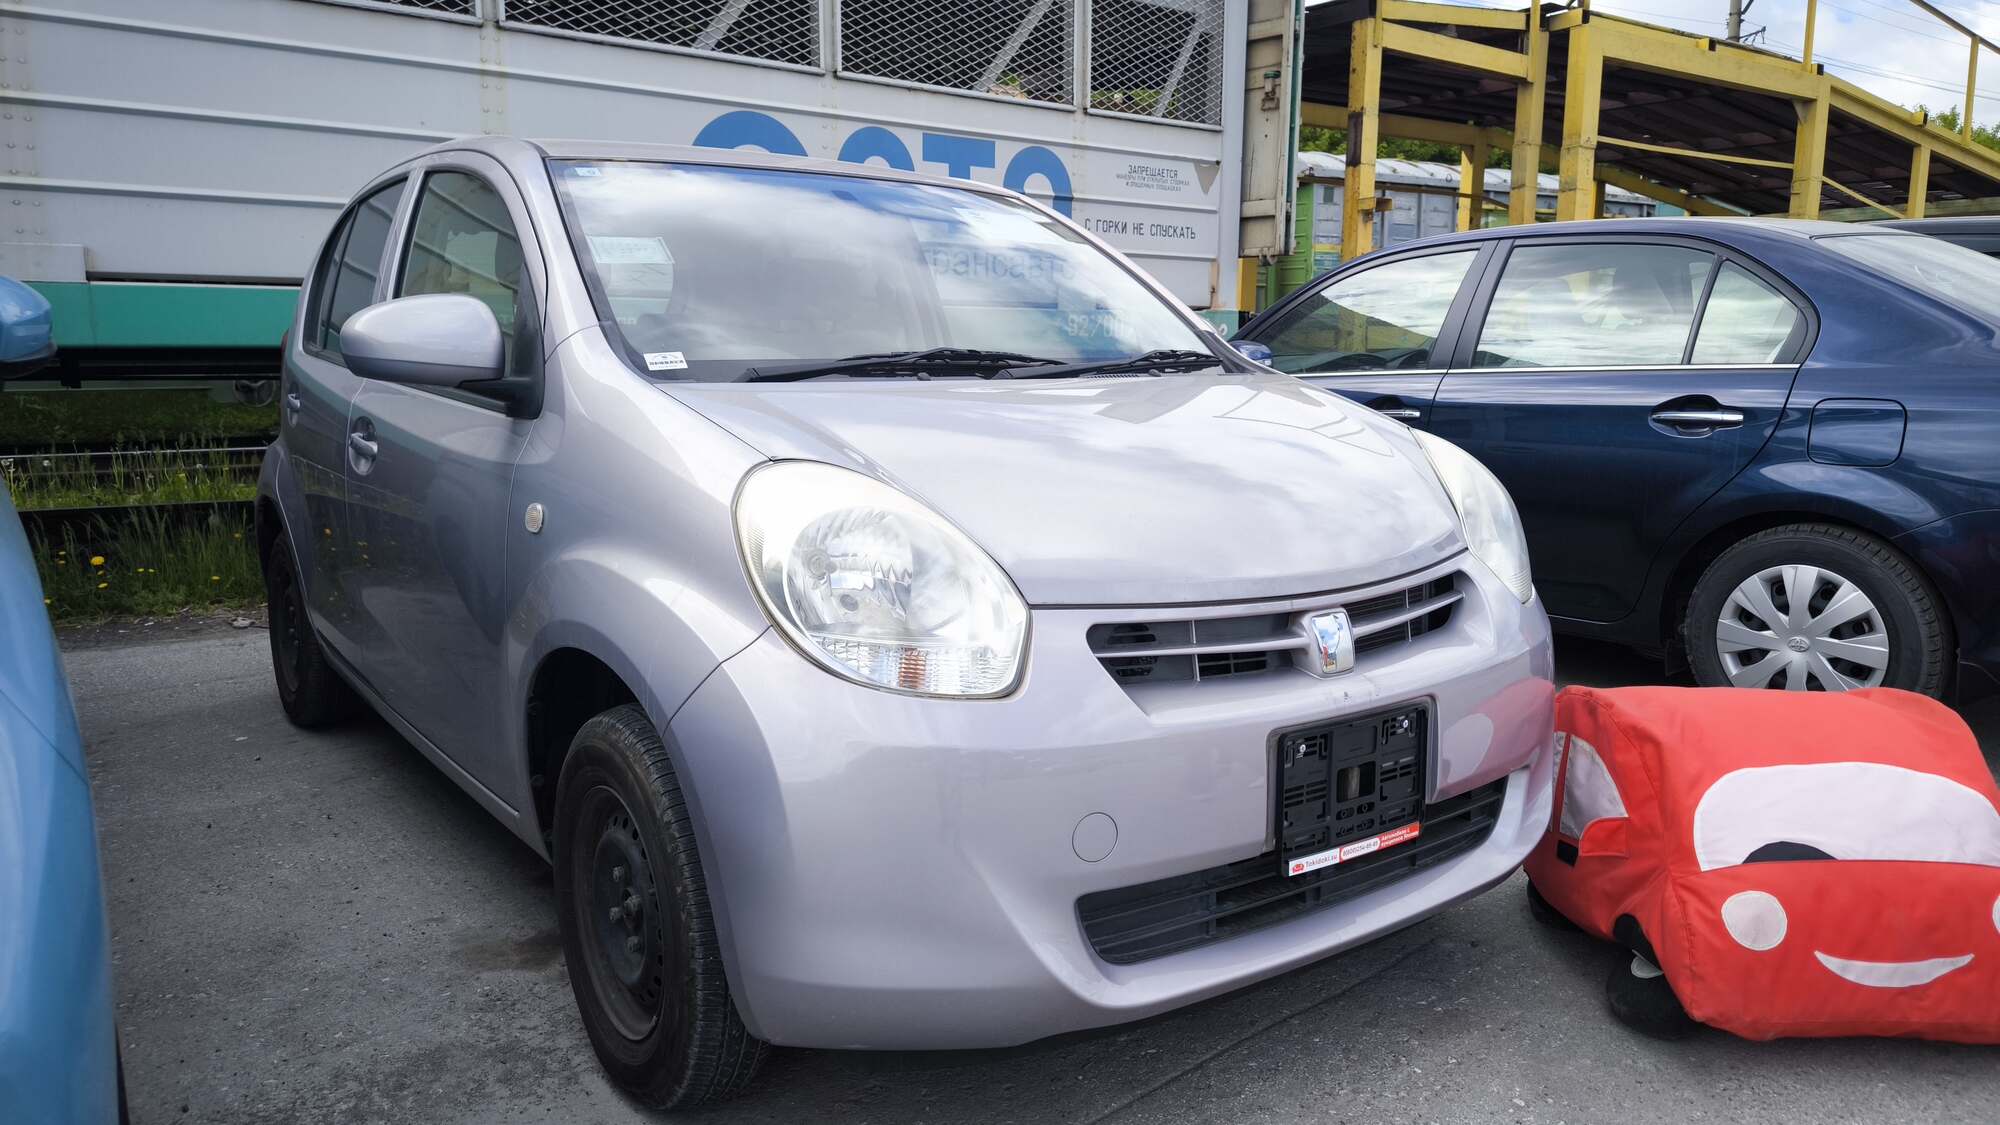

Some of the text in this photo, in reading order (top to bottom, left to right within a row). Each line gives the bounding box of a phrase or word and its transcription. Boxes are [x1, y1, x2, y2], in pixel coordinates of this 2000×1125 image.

[1128, 164, 1178, 179] ЗАПРЕЩАЕТСЯ
[1084, 218, 1196, 239] С ГОРКИ НЕ СПУСКАТЬ
